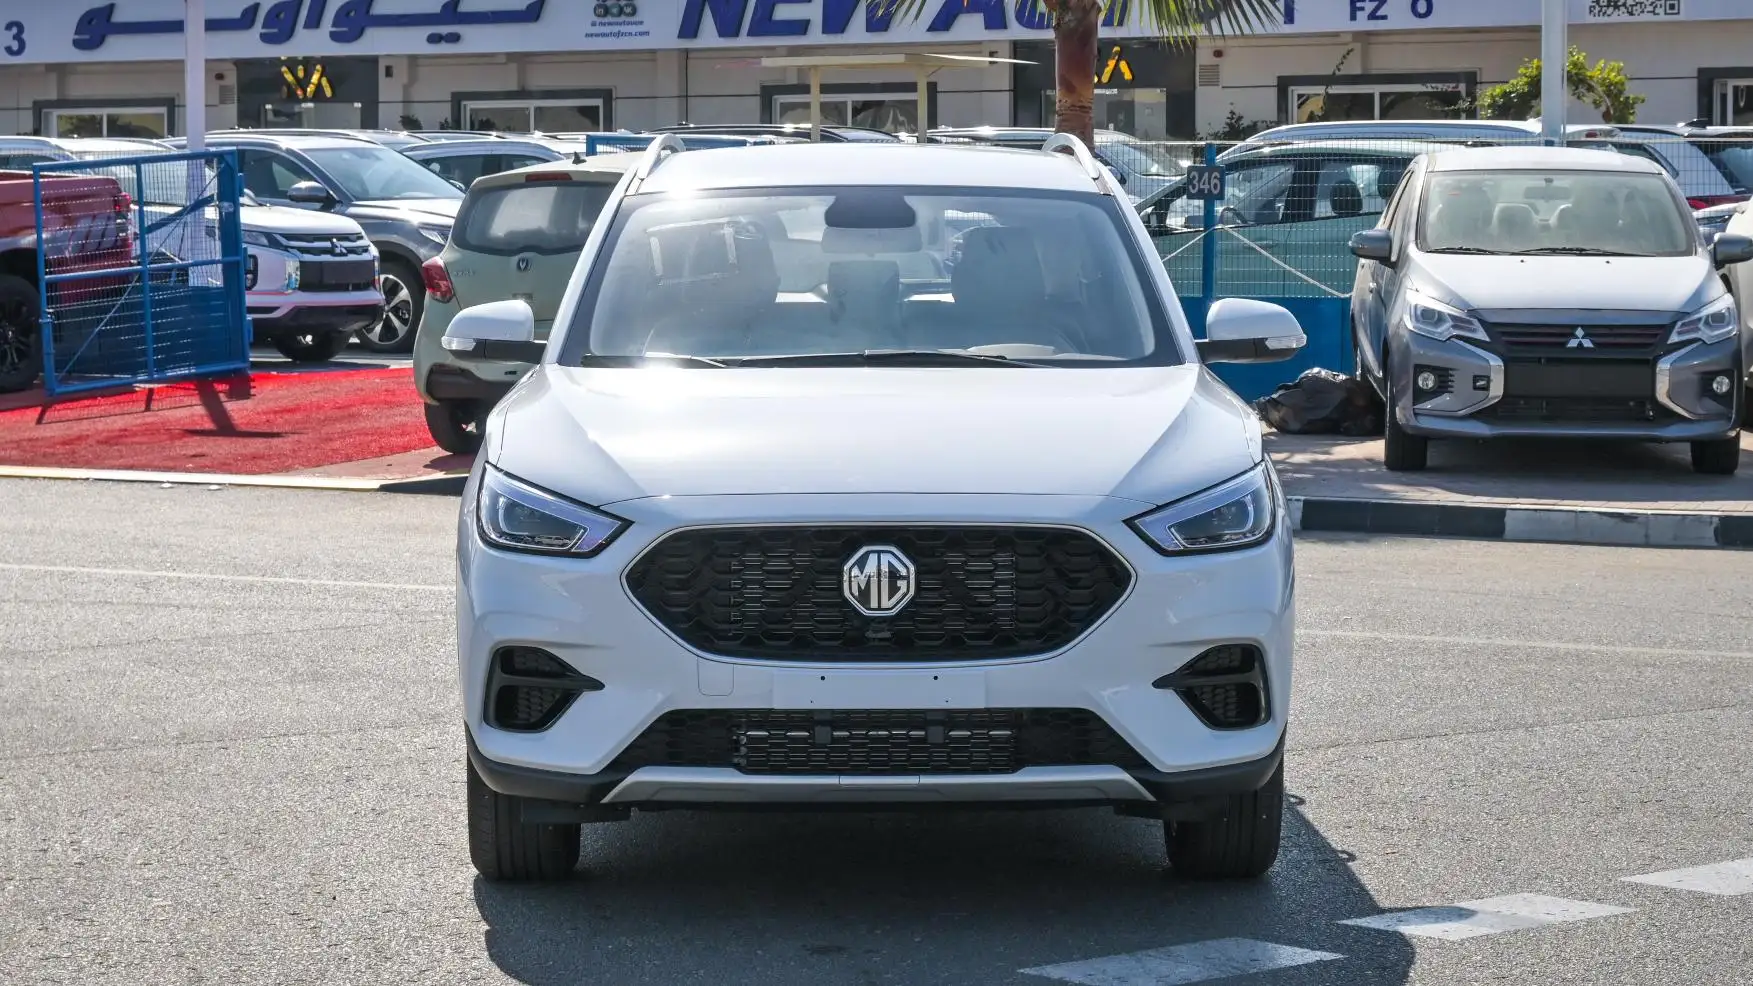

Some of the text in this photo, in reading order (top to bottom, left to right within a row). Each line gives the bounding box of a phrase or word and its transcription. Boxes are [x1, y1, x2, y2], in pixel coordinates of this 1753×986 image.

[4, 20, 26, 57] 3
[1189, 171, 1221, 194] 346
[850, 552, 908, 609] MG
